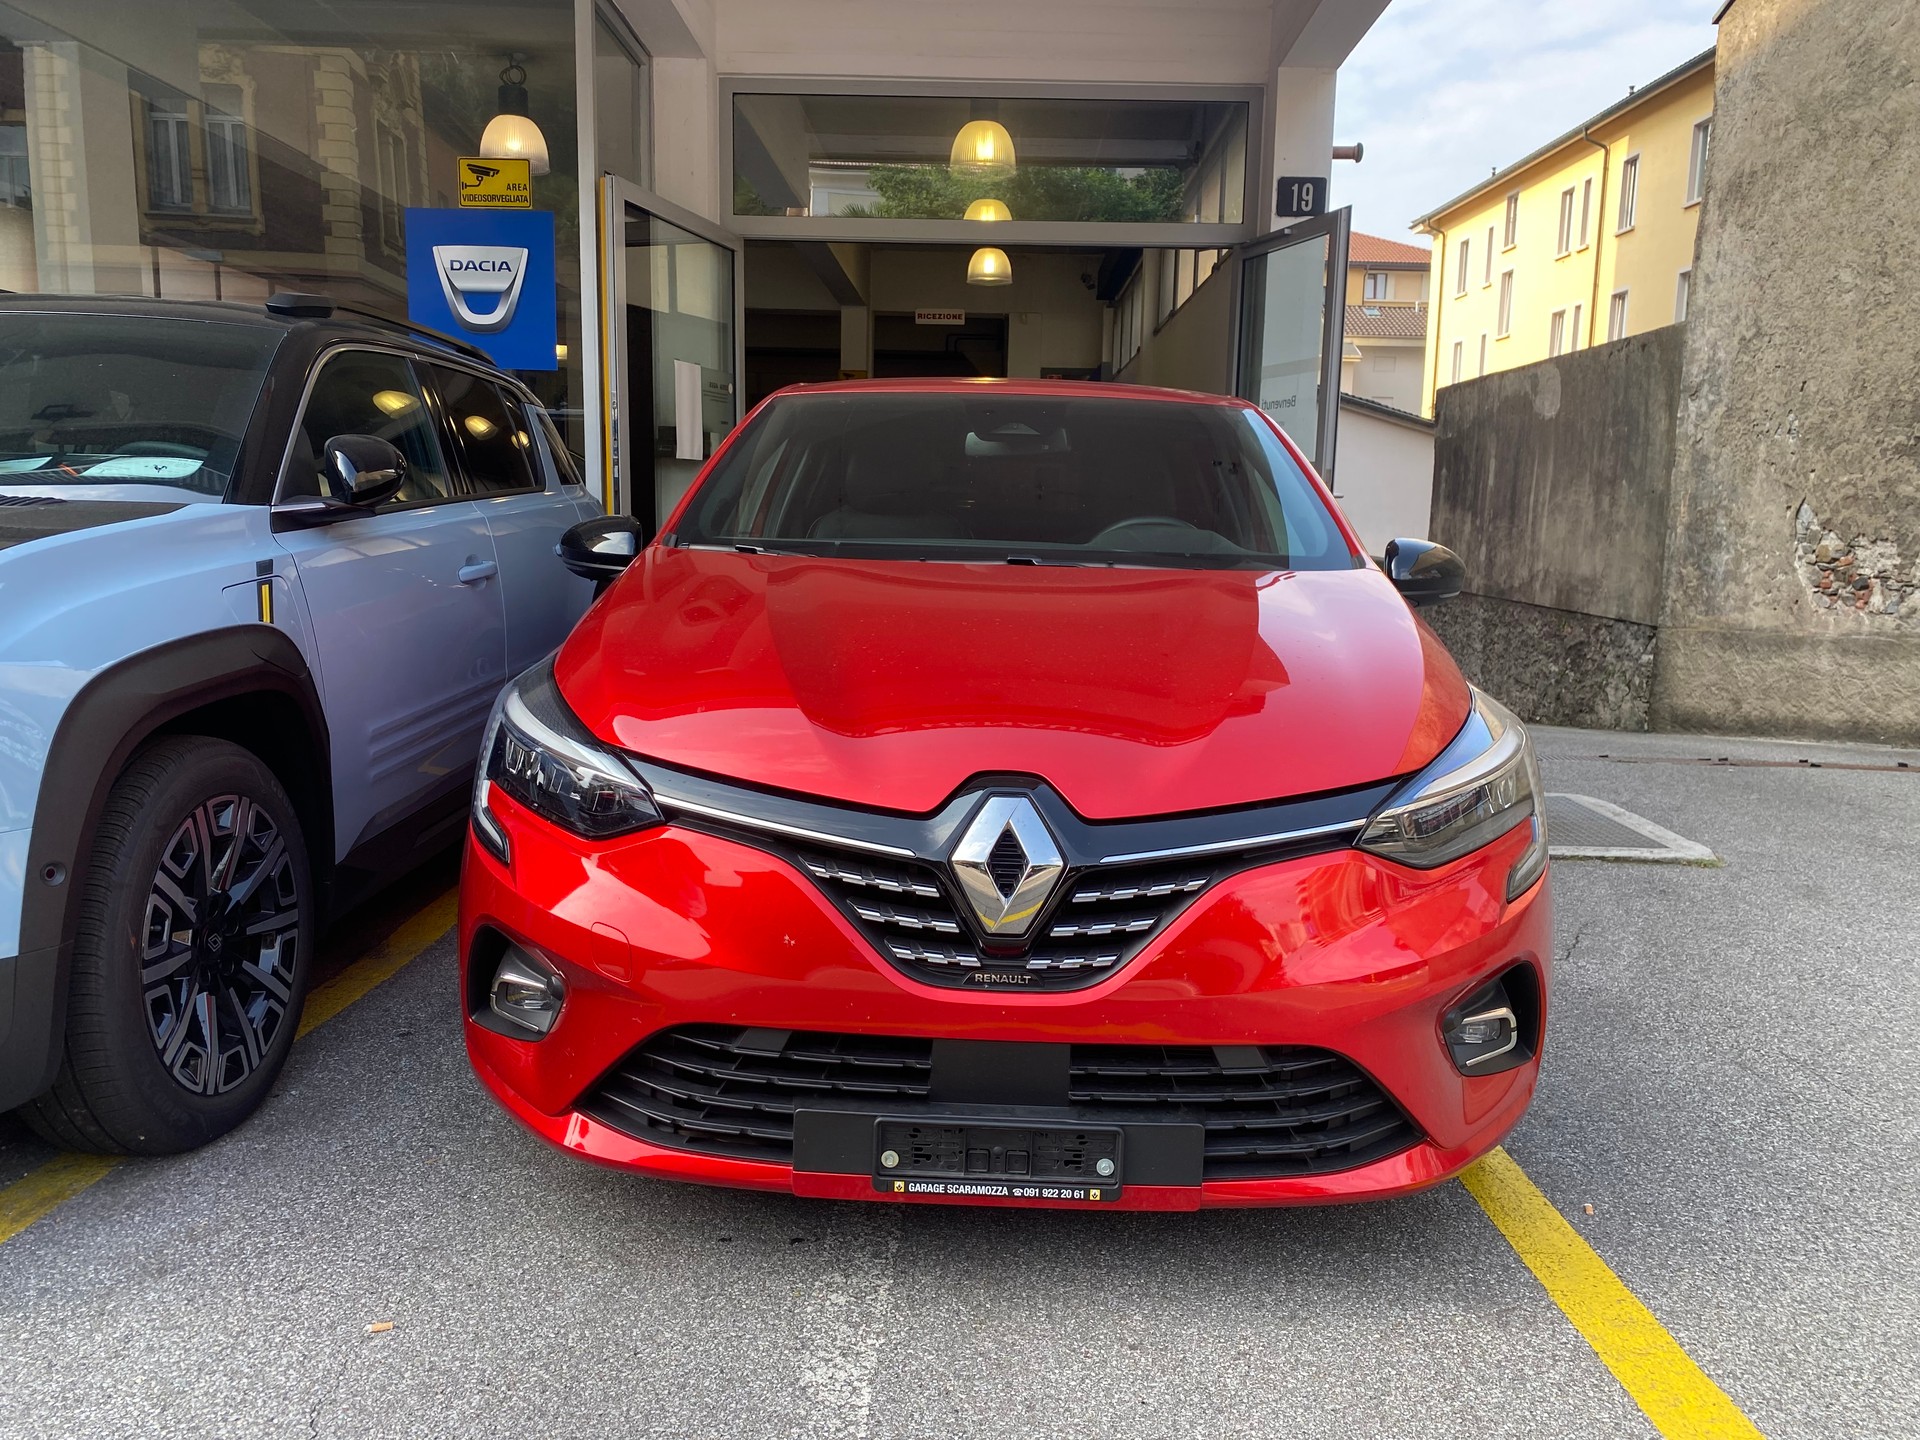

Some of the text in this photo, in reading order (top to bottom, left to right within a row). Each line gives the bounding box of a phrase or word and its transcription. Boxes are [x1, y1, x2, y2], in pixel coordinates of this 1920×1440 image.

[506, 183, 528, 191] AREA
[462, 194, 528, 203] VIDEOSORVEGLIATA
[1291, 183, 1314, 212] 19
[450, 260, 512, 272] DACIA
[974, 973, 1032, 984] RENAULT
[908, 1182, 1085, 1199] GARAGE SCARAMOZZA 091 922 20 61
